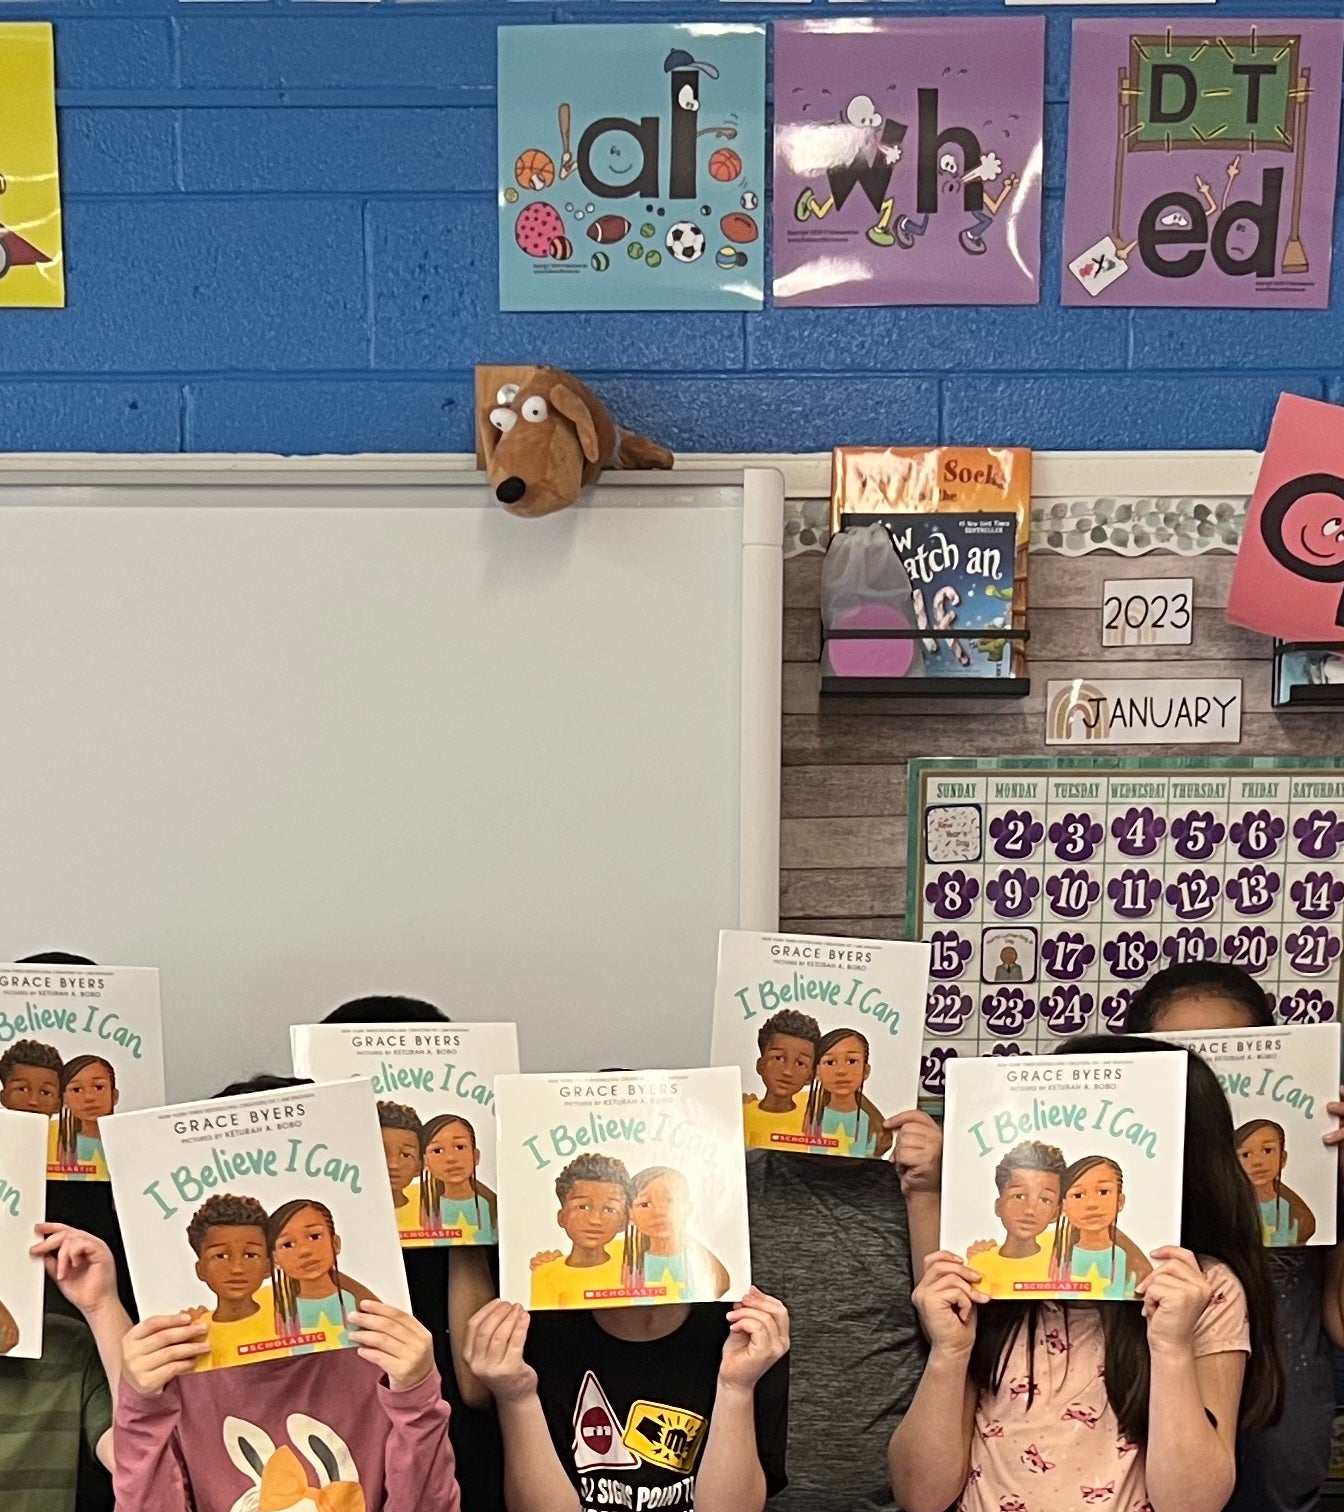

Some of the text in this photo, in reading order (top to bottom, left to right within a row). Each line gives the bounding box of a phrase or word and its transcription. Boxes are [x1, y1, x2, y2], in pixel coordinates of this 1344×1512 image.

[1149, 65, 1277, 124] D T
[578, 69, 698, 198] al
[827, 89, 983, 213] wh
[1138, 167, 1284, 278] ed
[903, 532, 1002, 580] atch an
[1105, 594, 1190, 630] 2023
[1083, 696, 1237, 729] JANUARY
[937, 783, 977, 799] SUNDAY
[995, 783, 1037, 799] MONDAY
[1054, 782, 1100, 799] TUESDAY
[1111, 782, 1166, 799] WEDNESDAY
[1172, 782, 1226, 799] THURSDAY
[1241, 782, 1278, 798] FRIDAY
[1004, 817, 1331, 853] 2 3 4 5 6 7
[1058, 879, 1331, 912] 10 11 12 14
[1234, 936, 1326, 966] 20 21
[173, 1112, 240, 1135] GRACE
[250, 1103, 307, 1124] BYERS
[143, 1138, 362, 1220] I Believe I Can
[636, 1482, 682, 1512] POINT
